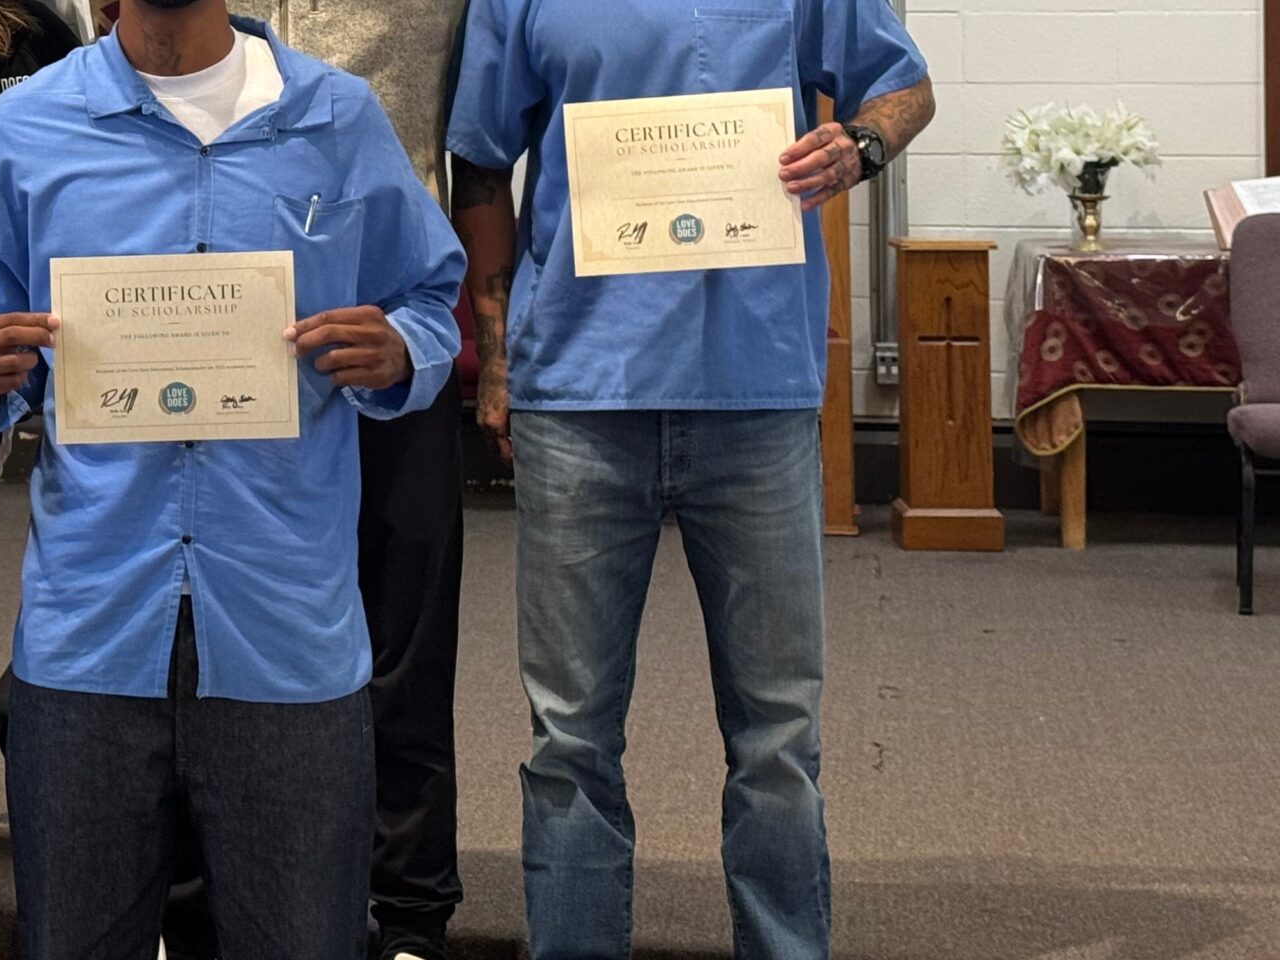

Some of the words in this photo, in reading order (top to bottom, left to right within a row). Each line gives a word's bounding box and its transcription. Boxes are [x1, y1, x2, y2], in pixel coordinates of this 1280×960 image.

[615, 119, 745, 143] CERTIFICATE
[616, 145, 635, 156] OF
[640, 139, 741, 155] SCHOLARSHIP
[676, 219, 696, 229] LOVE
[676, 229, 697, 238] DOES
[105, 283, 243, 304] CERTIFICATE
[105, 307, 122, 318] OF
[131, 304, 238, 317] SCHOLARSHIP
[167, 388, 188, 397] LOVE
[167, 397, 189, 407] DOES
